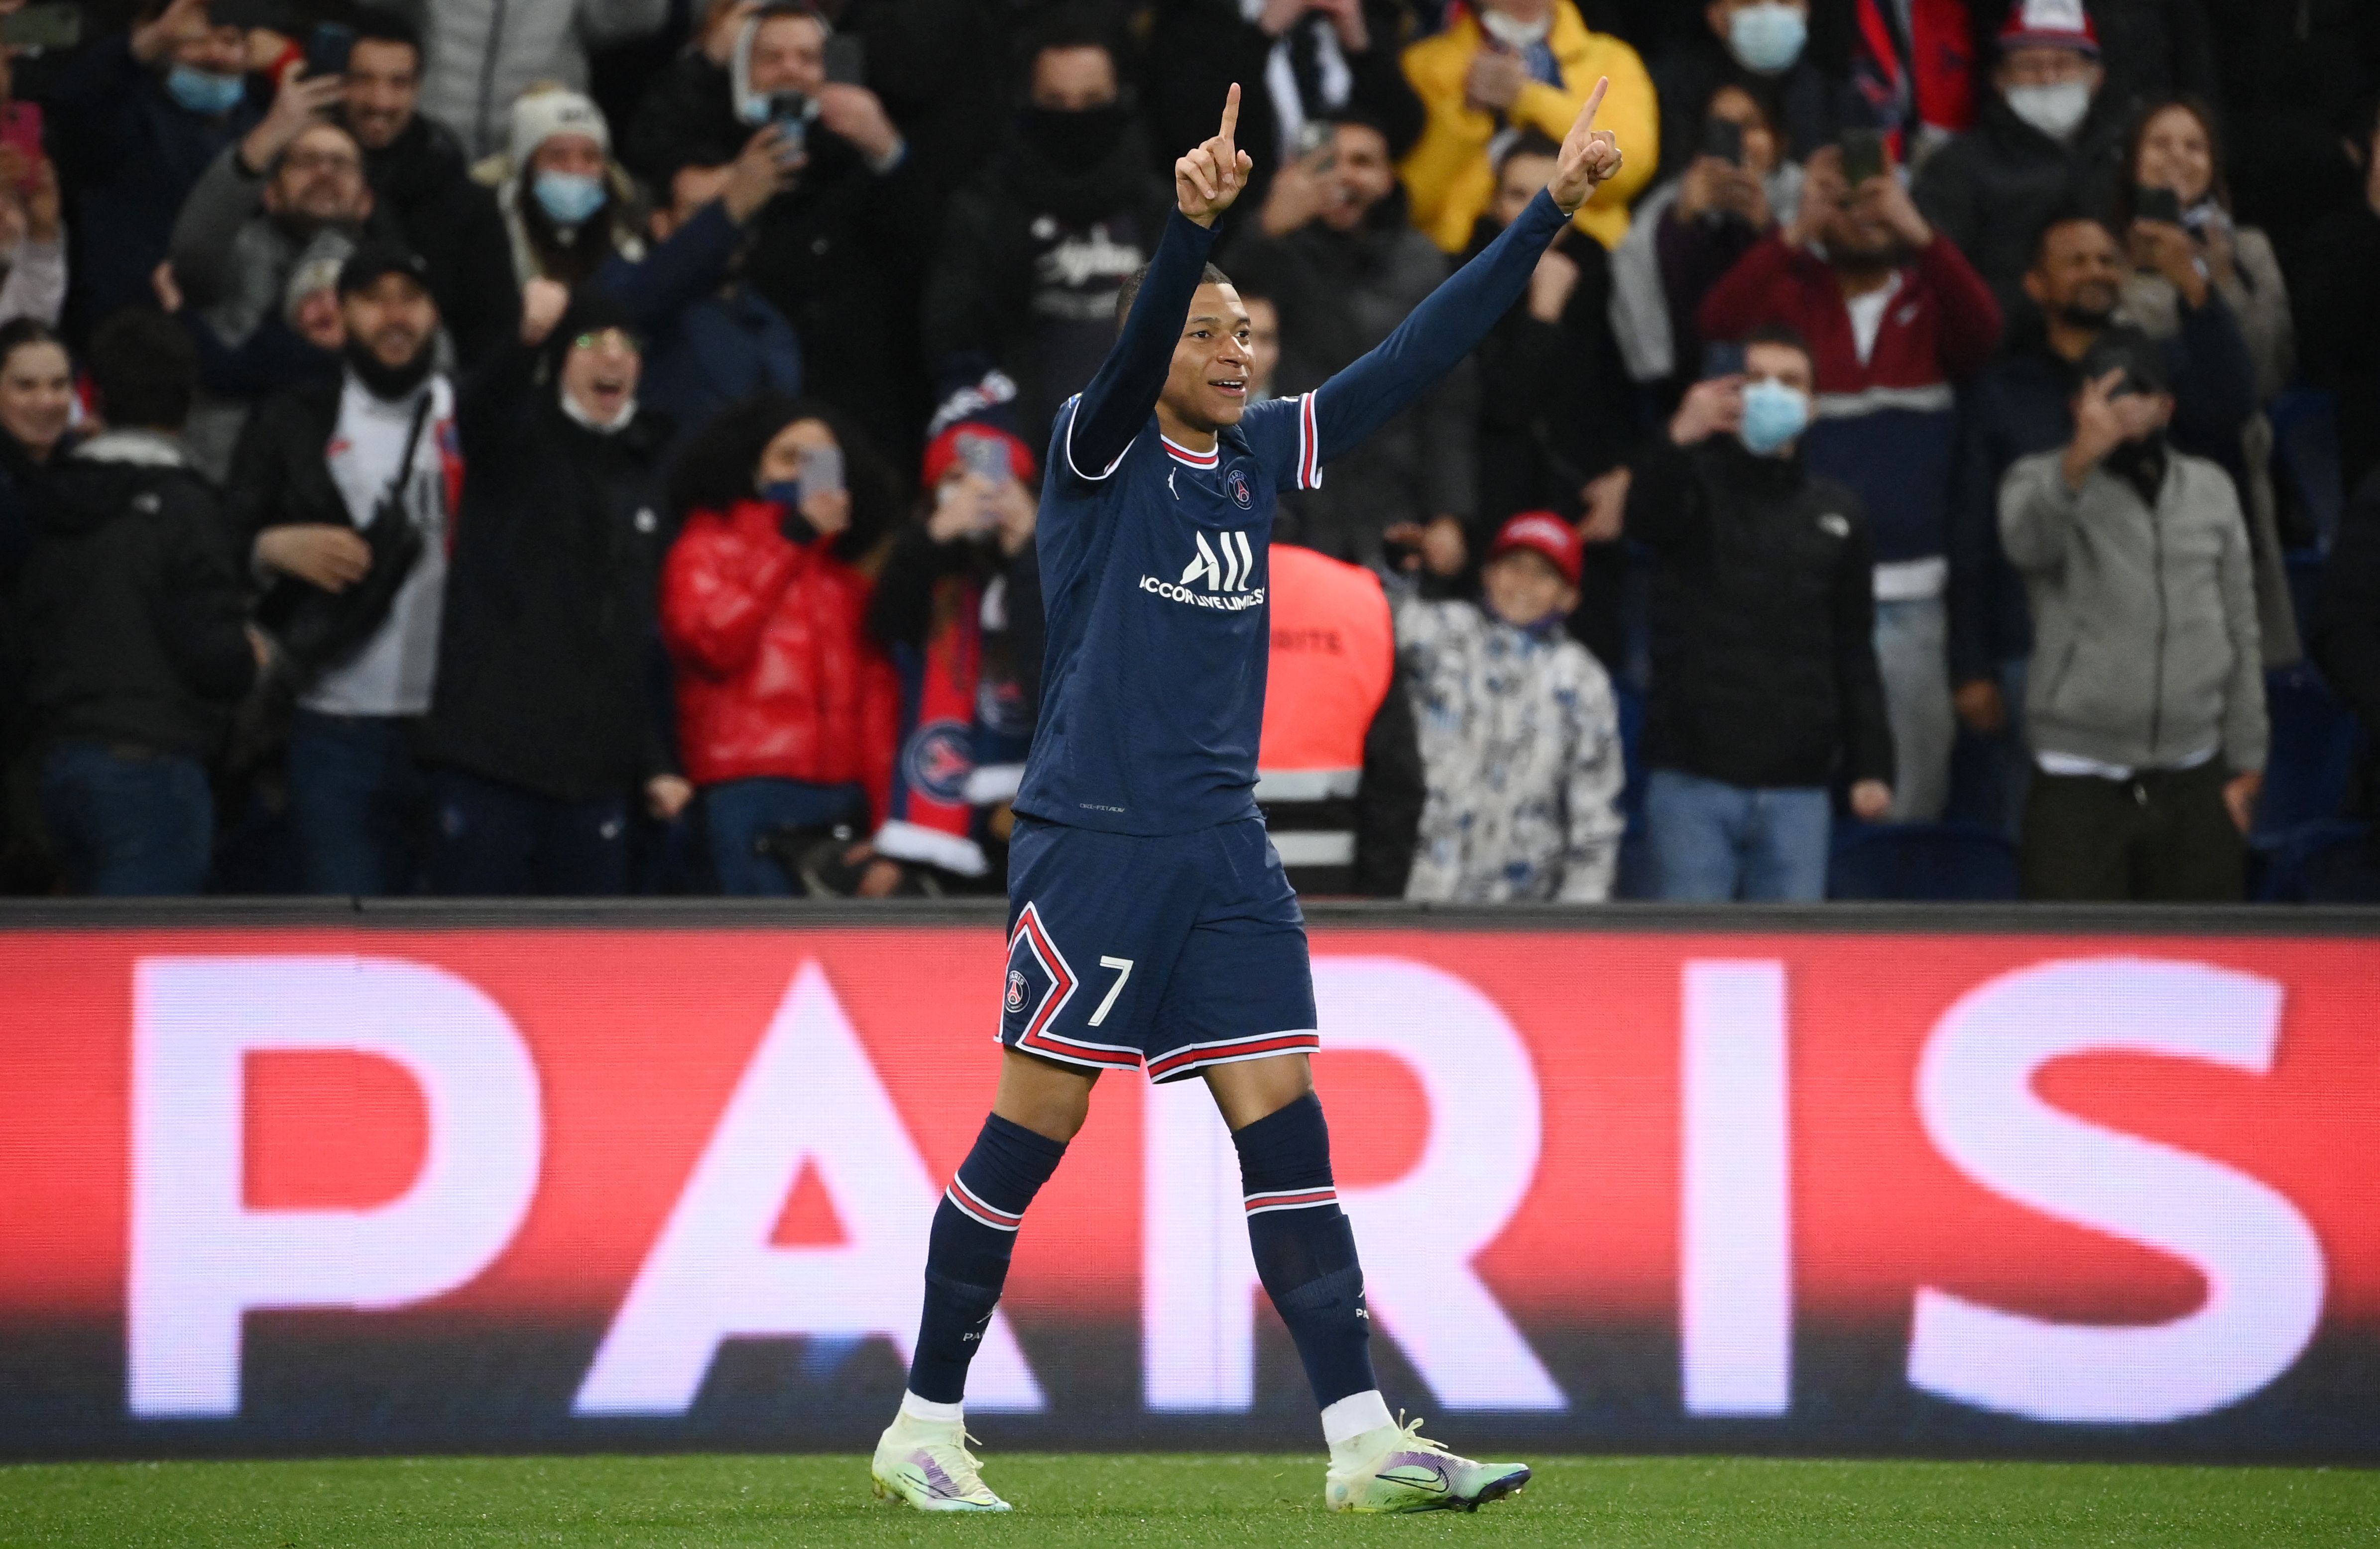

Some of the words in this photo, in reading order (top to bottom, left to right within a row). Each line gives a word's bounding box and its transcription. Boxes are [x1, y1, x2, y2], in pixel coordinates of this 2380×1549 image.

[1229, 471, 1245, 484] PARIS
[1193, 594, 1225, 610] LIVE
[1087, 955, 1134, 1027] 7
[126, 956, 2327, 1423] PARIS
